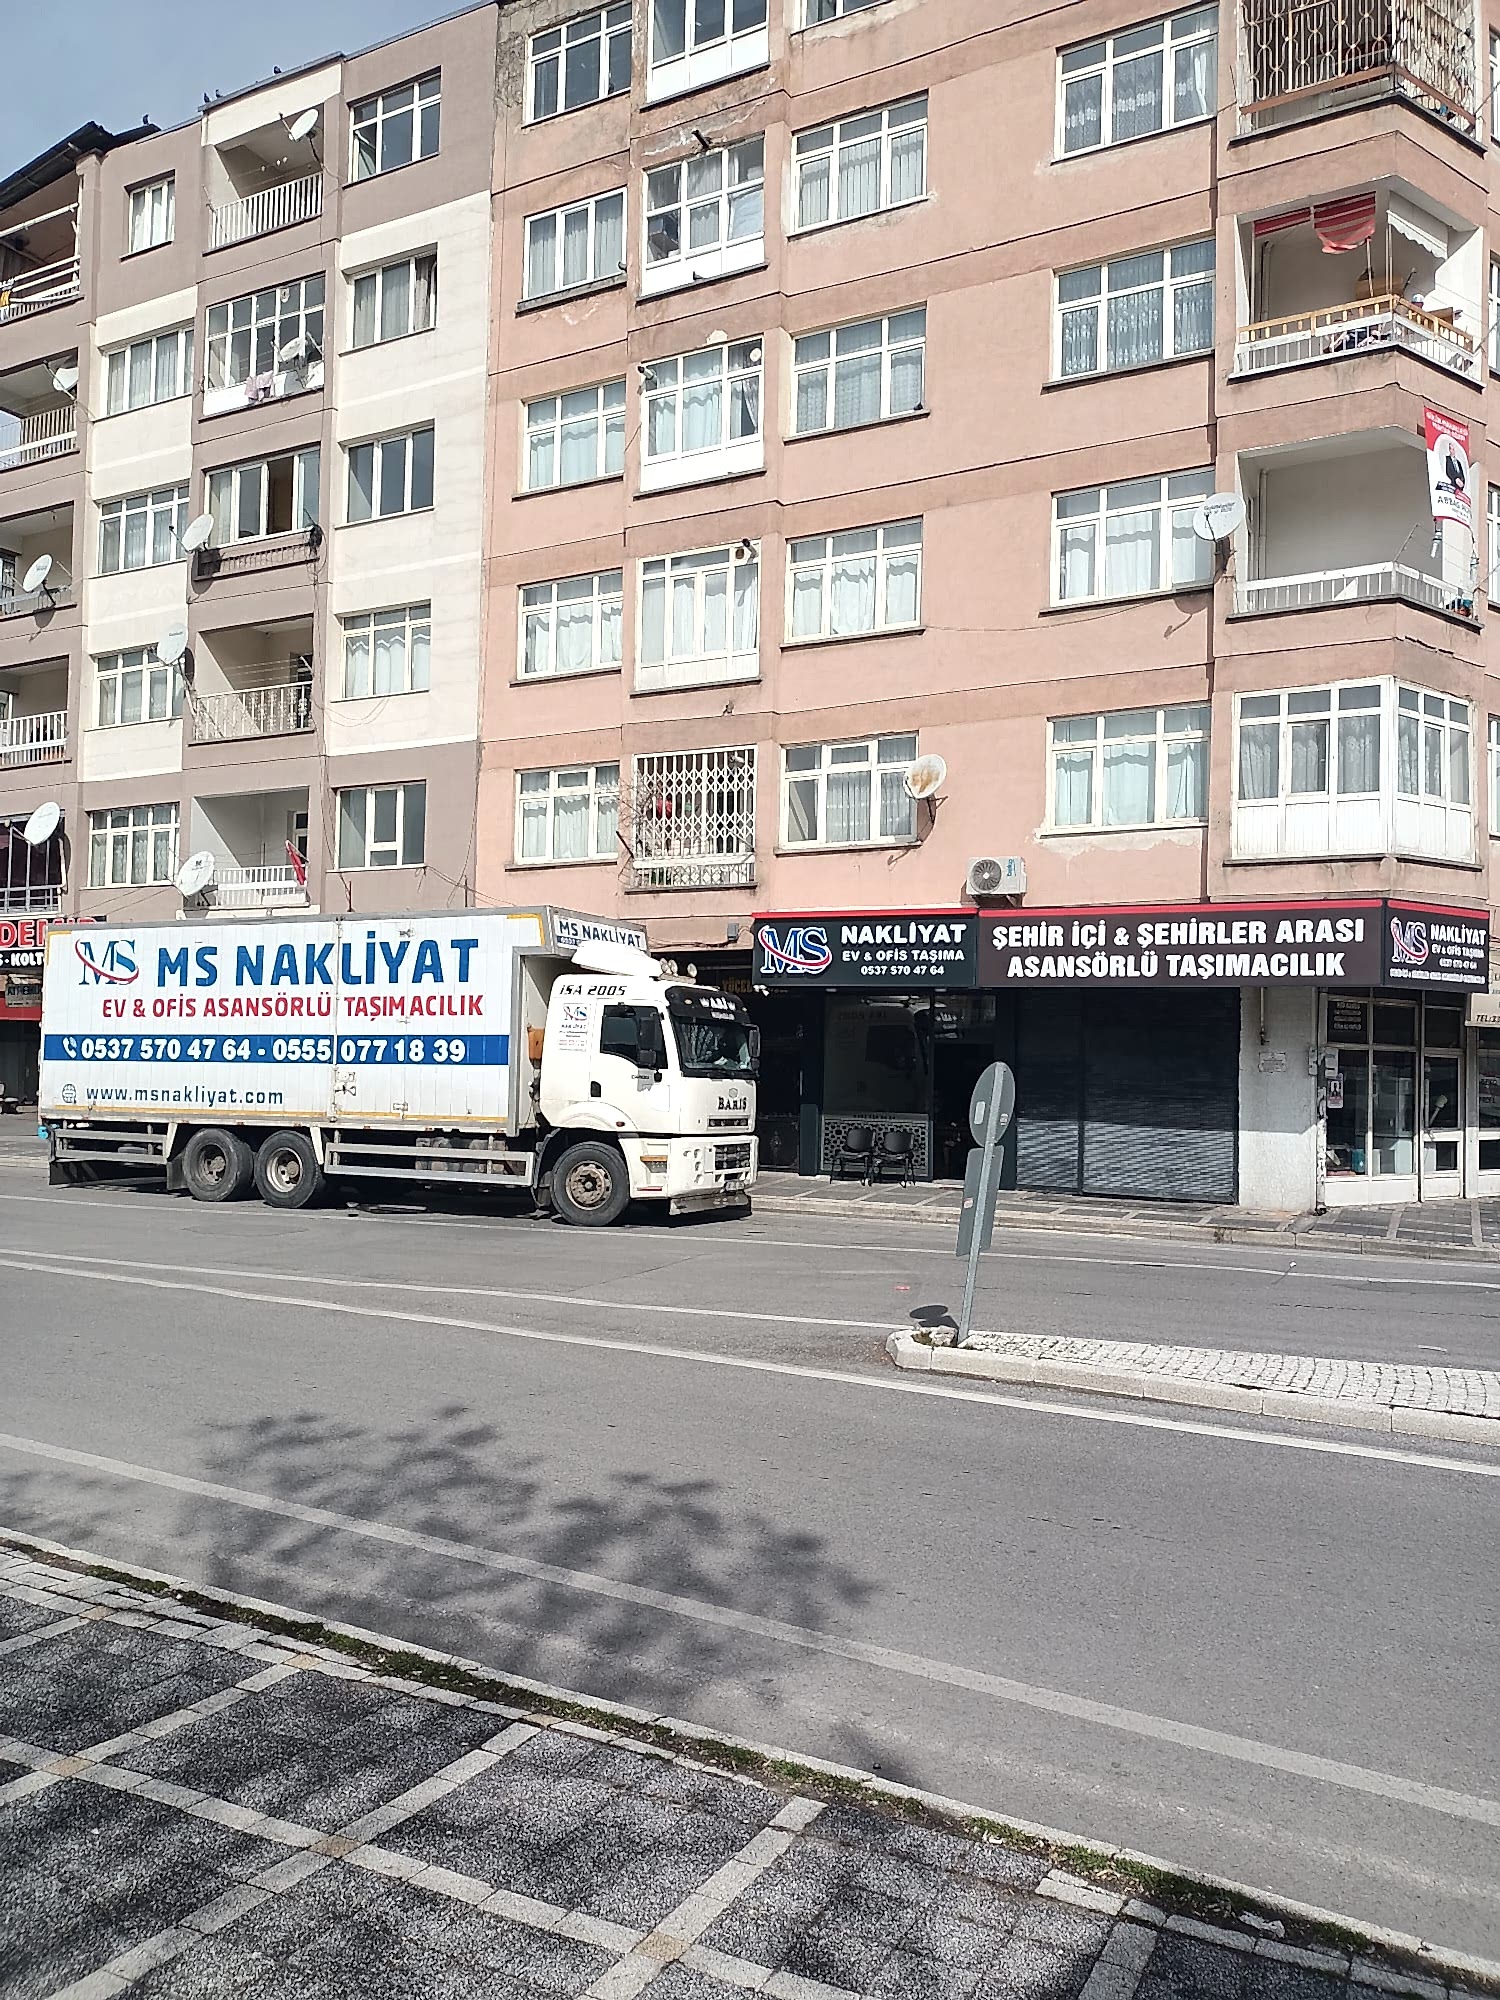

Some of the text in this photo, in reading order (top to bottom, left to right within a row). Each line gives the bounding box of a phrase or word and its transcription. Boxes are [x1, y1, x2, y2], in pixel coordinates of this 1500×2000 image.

[560, 920, 579, 937] MS
[582, 924, 641, 948] NAKLİYAT
[841, 922, 967, 945] NAKLİYAT
[992, 917, 1364, 950] ŞEHİR İÇİ & ŞEHİRLER ARASI
[1430, 923, 1487, 946] NAKLİYAT
[10, 952, 45, 967] KOLT
[75, 938, 139, 985] MS
[157, 931, 478, 987] MS NAKLİYAT
[759, 924, 832, 975] MS
[842, 948, 965, 965] EV & OFİS TAŞIMA
[861, 965, 945, 976] 0537 570 47 64
[1007, 951, 1345, 980] ASANSÖRLÜ TAŞIMACILIK
[587, 985, 628, 996] 2005
[102, 992, 484, 1022] EV & OFİS ASANSÖRLÜ TAŞIMACILIK
[81, 1039, 133, 1060] 0537
[140, 1038, 182, 1060] 570
[186, 1038, 216, 1060] 47
[222, 1038, 251, 1060] 64
[272, 1038, 332, 1062] 0555
[340, 1038, 388, 1061] 077
[394, 1038, 425, 1062] 18
[432, 1038, 466, 1062] 39
[86, 1085, 284, 1107] www.msnakliyat.com
